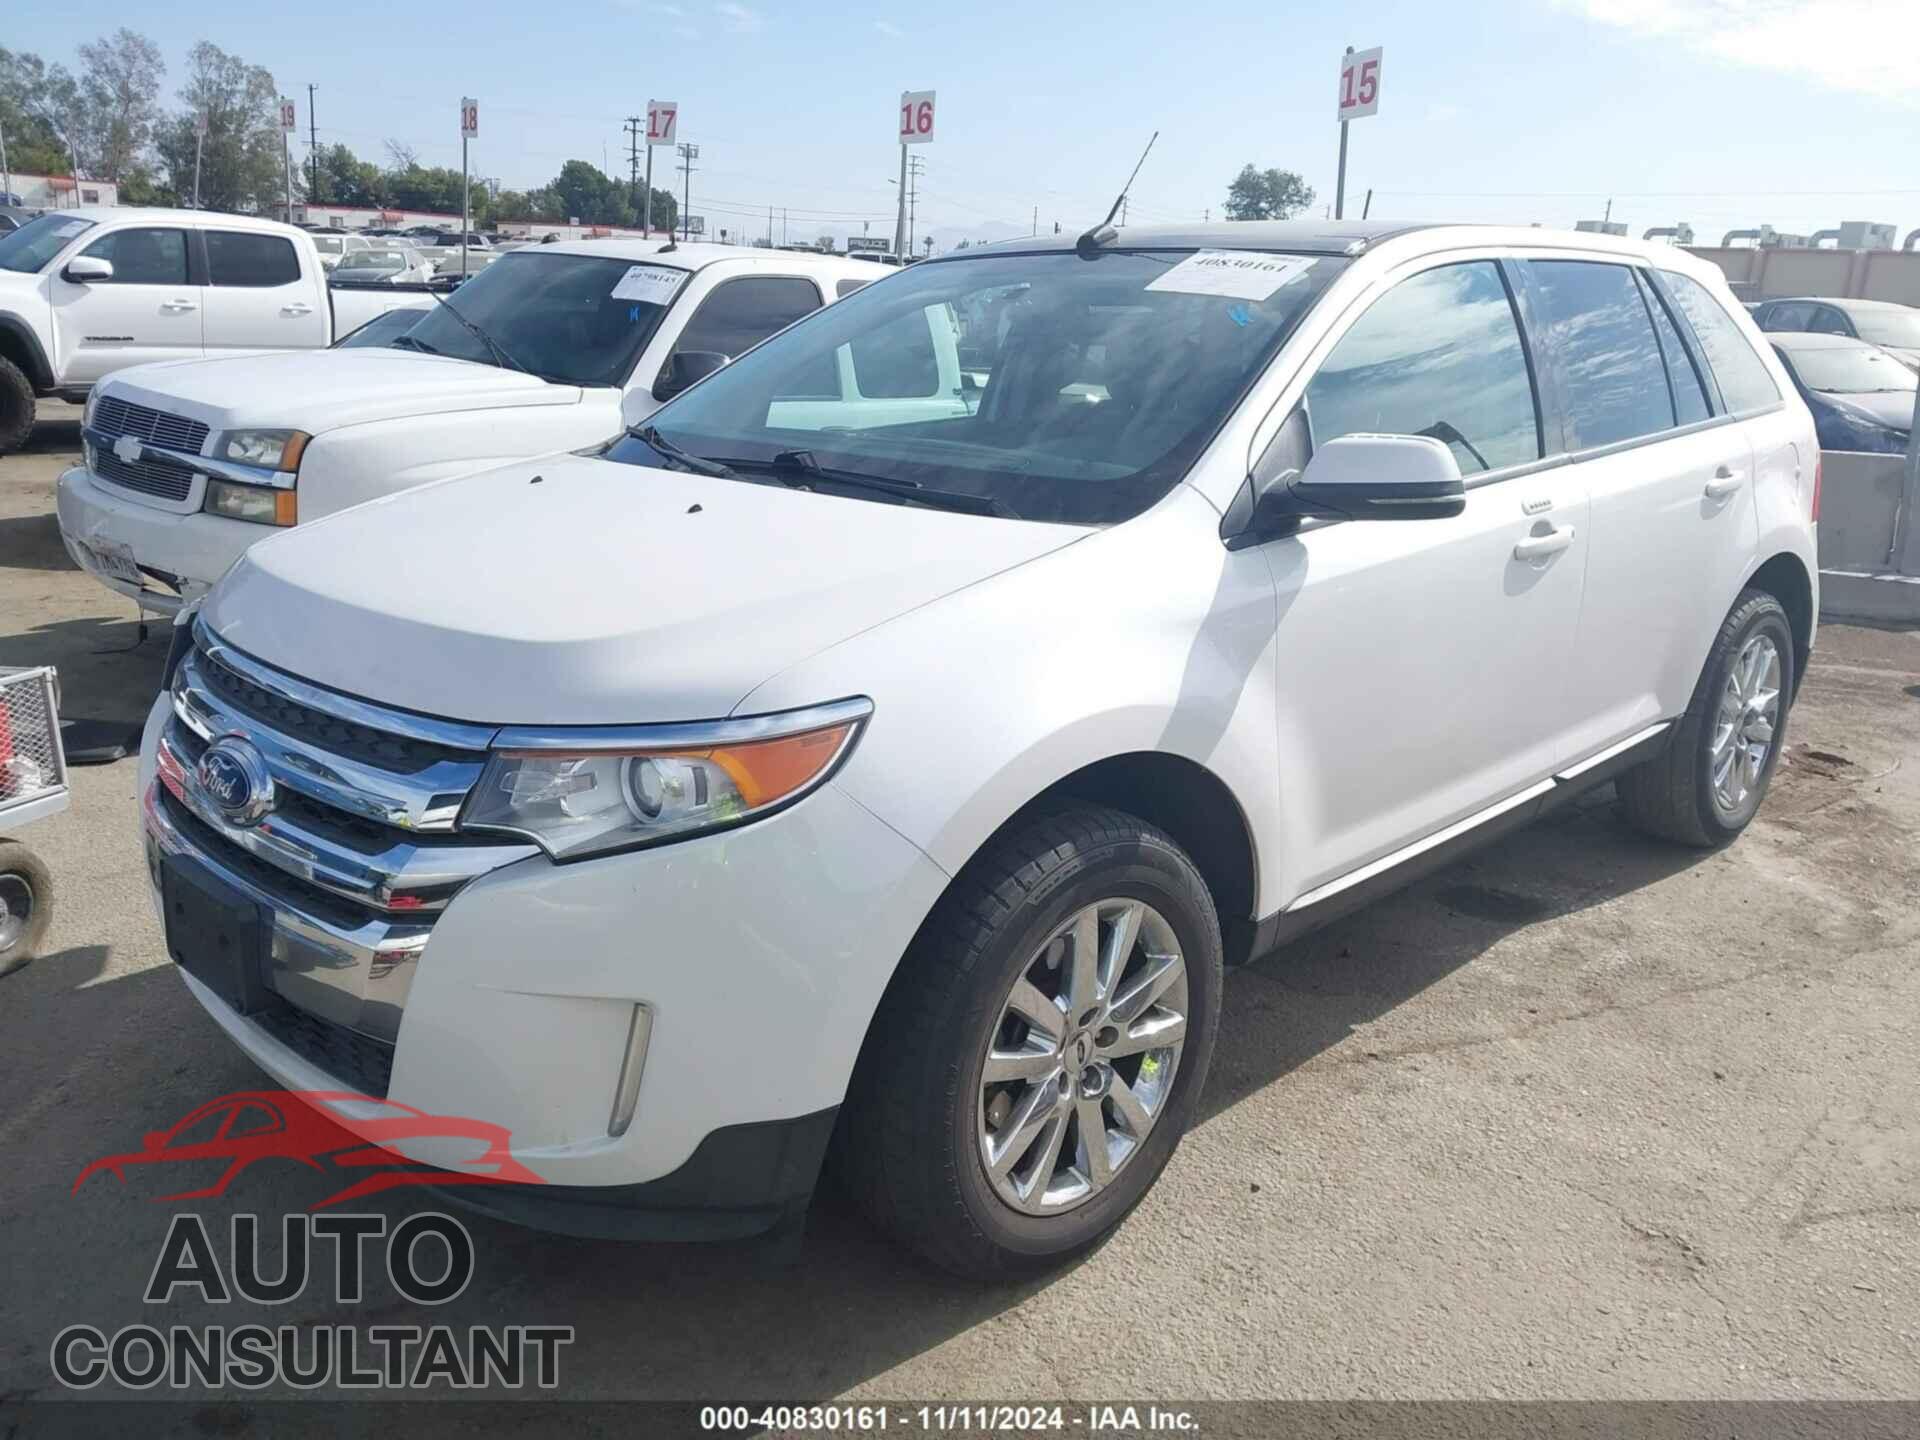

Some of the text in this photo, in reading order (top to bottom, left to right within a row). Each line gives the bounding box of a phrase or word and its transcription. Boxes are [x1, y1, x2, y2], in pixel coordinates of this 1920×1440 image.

[1341, 59, 1378, 108] 15
[281, 105, 295, 127] 19
[462, 107, 478, 130] 18
[647, 110, 676, 138] 17
[901, 101, 932, 134] 16
[204, 756, 238, 800] Ford
